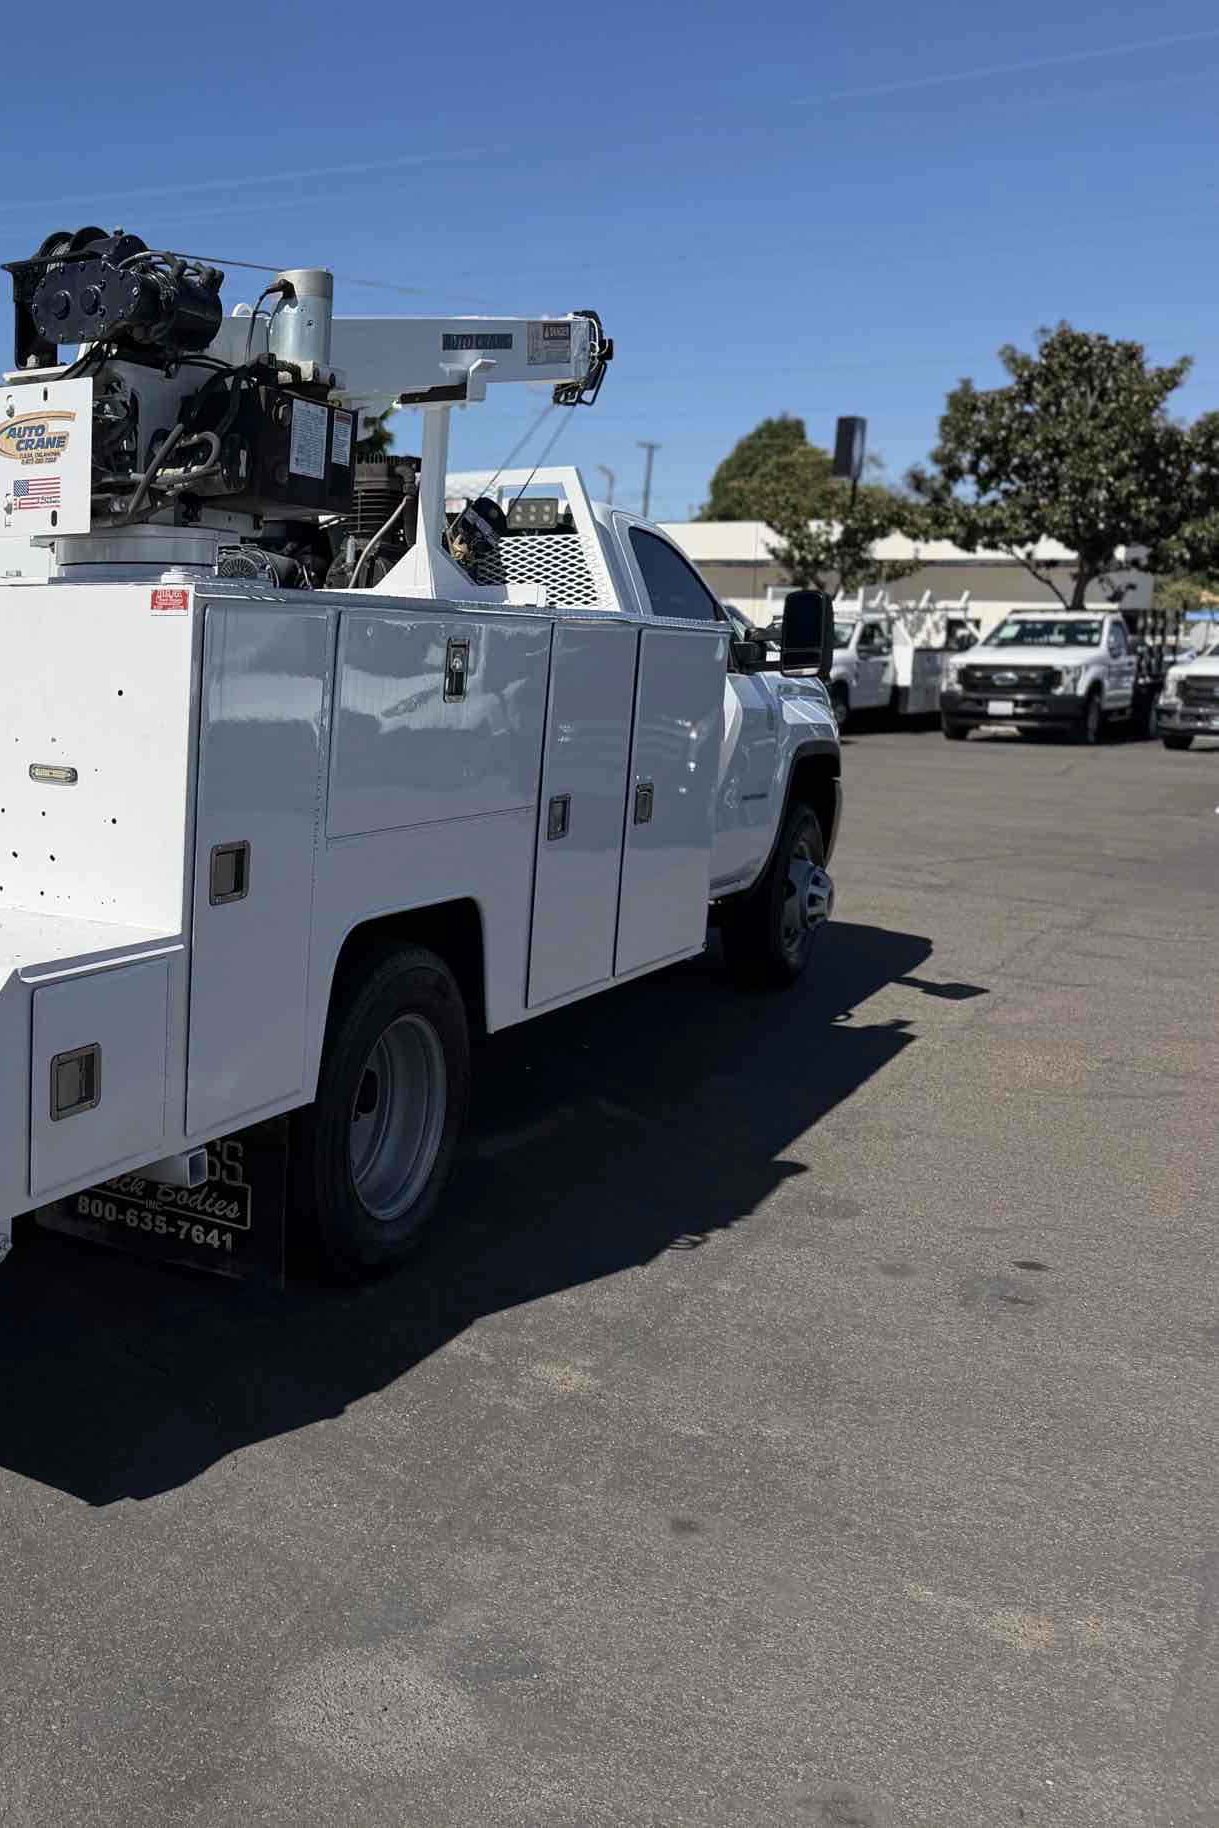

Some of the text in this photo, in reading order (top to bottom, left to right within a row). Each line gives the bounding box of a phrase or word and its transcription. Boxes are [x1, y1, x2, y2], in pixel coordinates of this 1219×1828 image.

[6, 424, 46, 439] AUTO
[15, 435, 67, 451] CRANE
[77, 1195, 234, 1253] 800-635-7641
